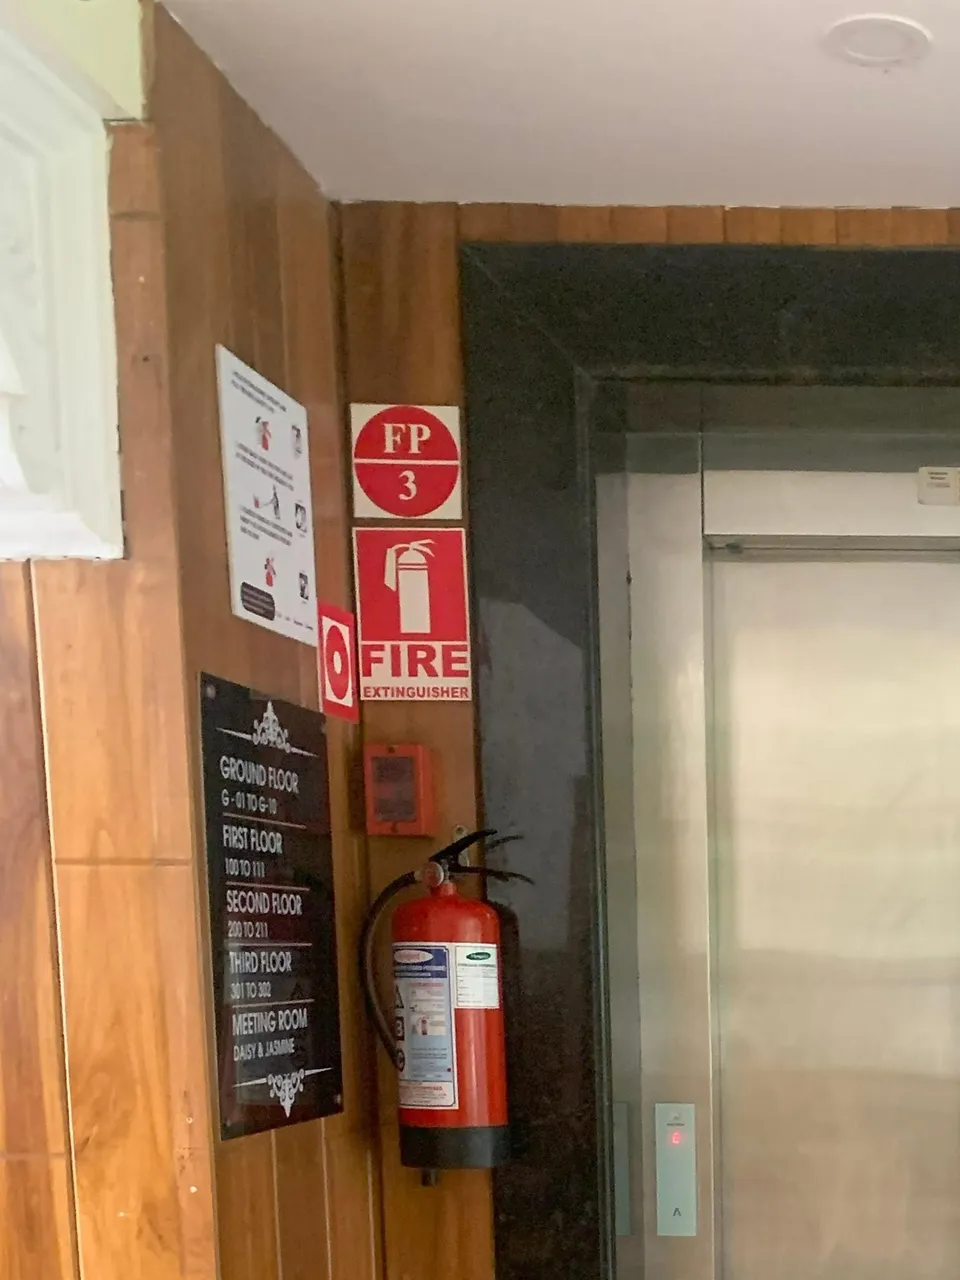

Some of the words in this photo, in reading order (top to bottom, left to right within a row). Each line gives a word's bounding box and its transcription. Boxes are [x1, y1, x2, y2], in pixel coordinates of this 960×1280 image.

[383, 423, 431, 454] FP
[398, 470, 417, 500] 3
[361, 644, 469, 678] FIRE
[363, 686, 469, 699] EXTINGUISHER
[220, 755, 267, 787] GROUND
[268, 766, 299, 793] FLOOR
[246, 792, 258, 812] TO
[223, 824, 248, 850] FIRST
[250, 828, 283, 854] FLOOR
[225, 857, 239, 876] 100
[239, 859, 251, 877] TO
[226, 889, 270, 914] SECOND
[271, 892, 303, 916] FLOOR
[243, 921, 254, 938] TO
[229, 951, 259, 974] THIRD
[260, 951, 293, 973] FLOOR
[245, 981, 257, 999] TO
[232, 1010, 277, 1037] MEETING
[278, 1007, 308, 1031] ROOM
[233, 1042, 257, 1062] DAISY
[265, 1037, 295, 1057] JASMINE
